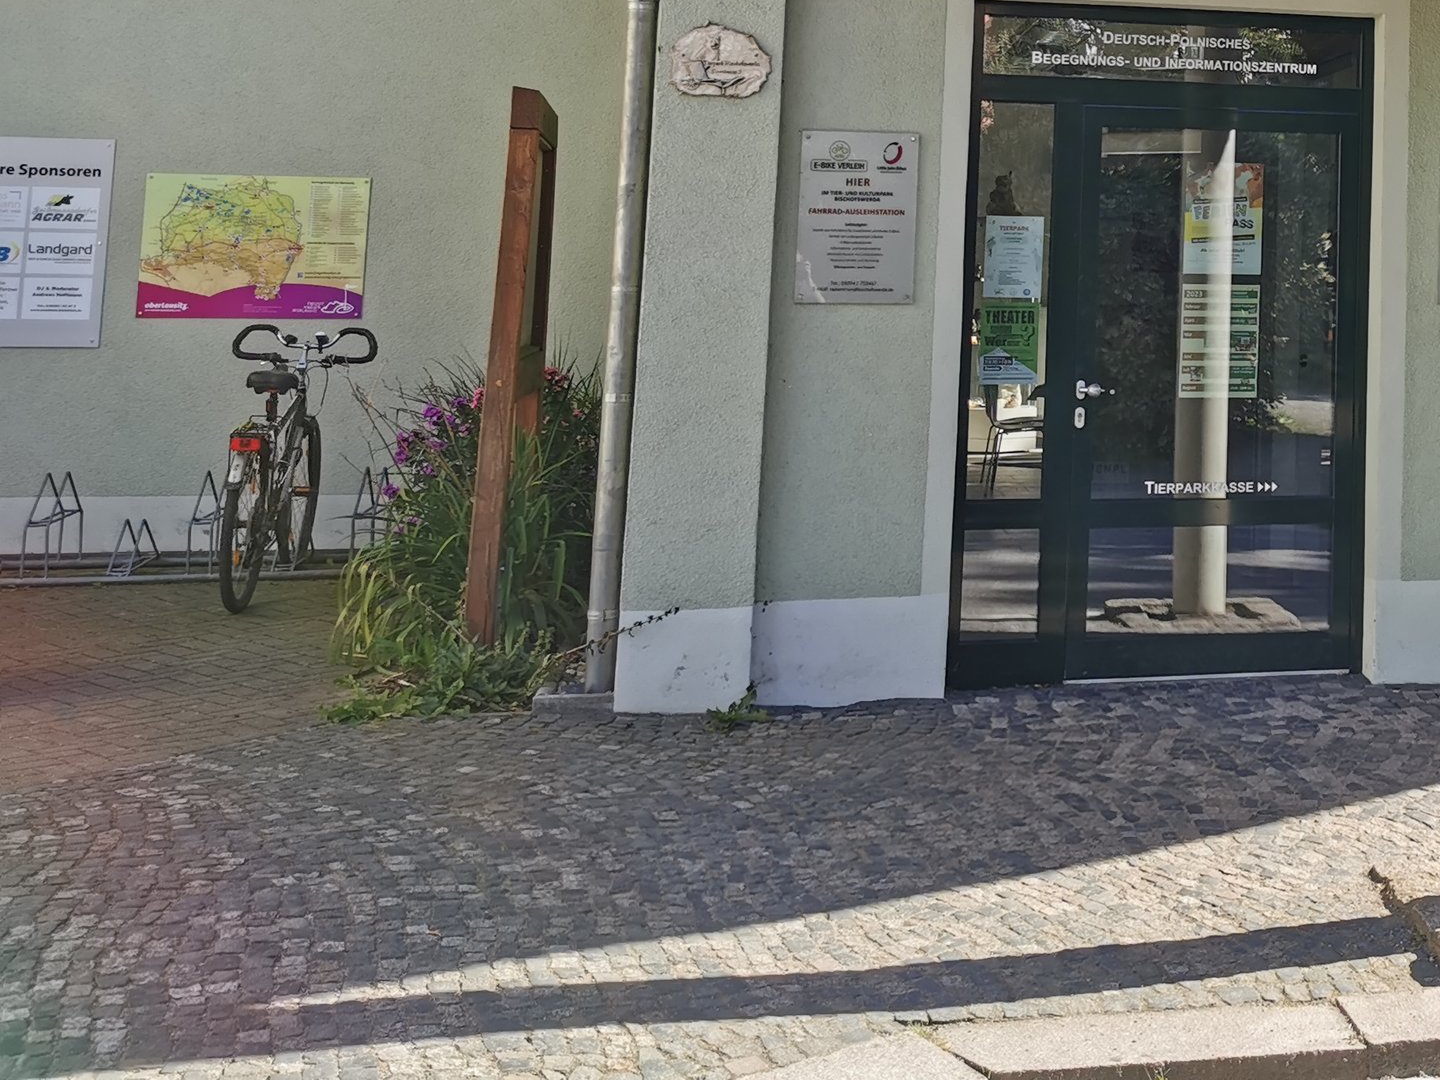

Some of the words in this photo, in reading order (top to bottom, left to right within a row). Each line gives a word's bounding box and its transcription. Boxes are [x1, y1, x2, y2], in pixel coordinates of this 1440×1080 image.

[1102, 31, 1251, 50] DEUTSCH-POLNISCHES
[1031, 51, 1131, 67] BEGEGNUNGS-
[1134, 57, 1162, 68] UND
[1165, 56, 1318, 74] INFORMATIONSZENTRUM
[0, 166, 15, 175] re
[18, 163, 102, 179] Sponsoren
[813, 161, 836, 169] E-BIKE
[838, 162, 865, 170] VERLEIH
[845, 178, 871, 187] HIER
[31, 213, 85, 222] AGRAR
[808, 207, 906, 216] FAHRRAD-AUSLEIHSTATION
[1232, 219, 1254, 229] ASS
[28, 243, 93, 257] Landgard
[985, 310, 1035, 324] THEATER
[1144, 481, 1254, 494] TIERPARKKASSE
